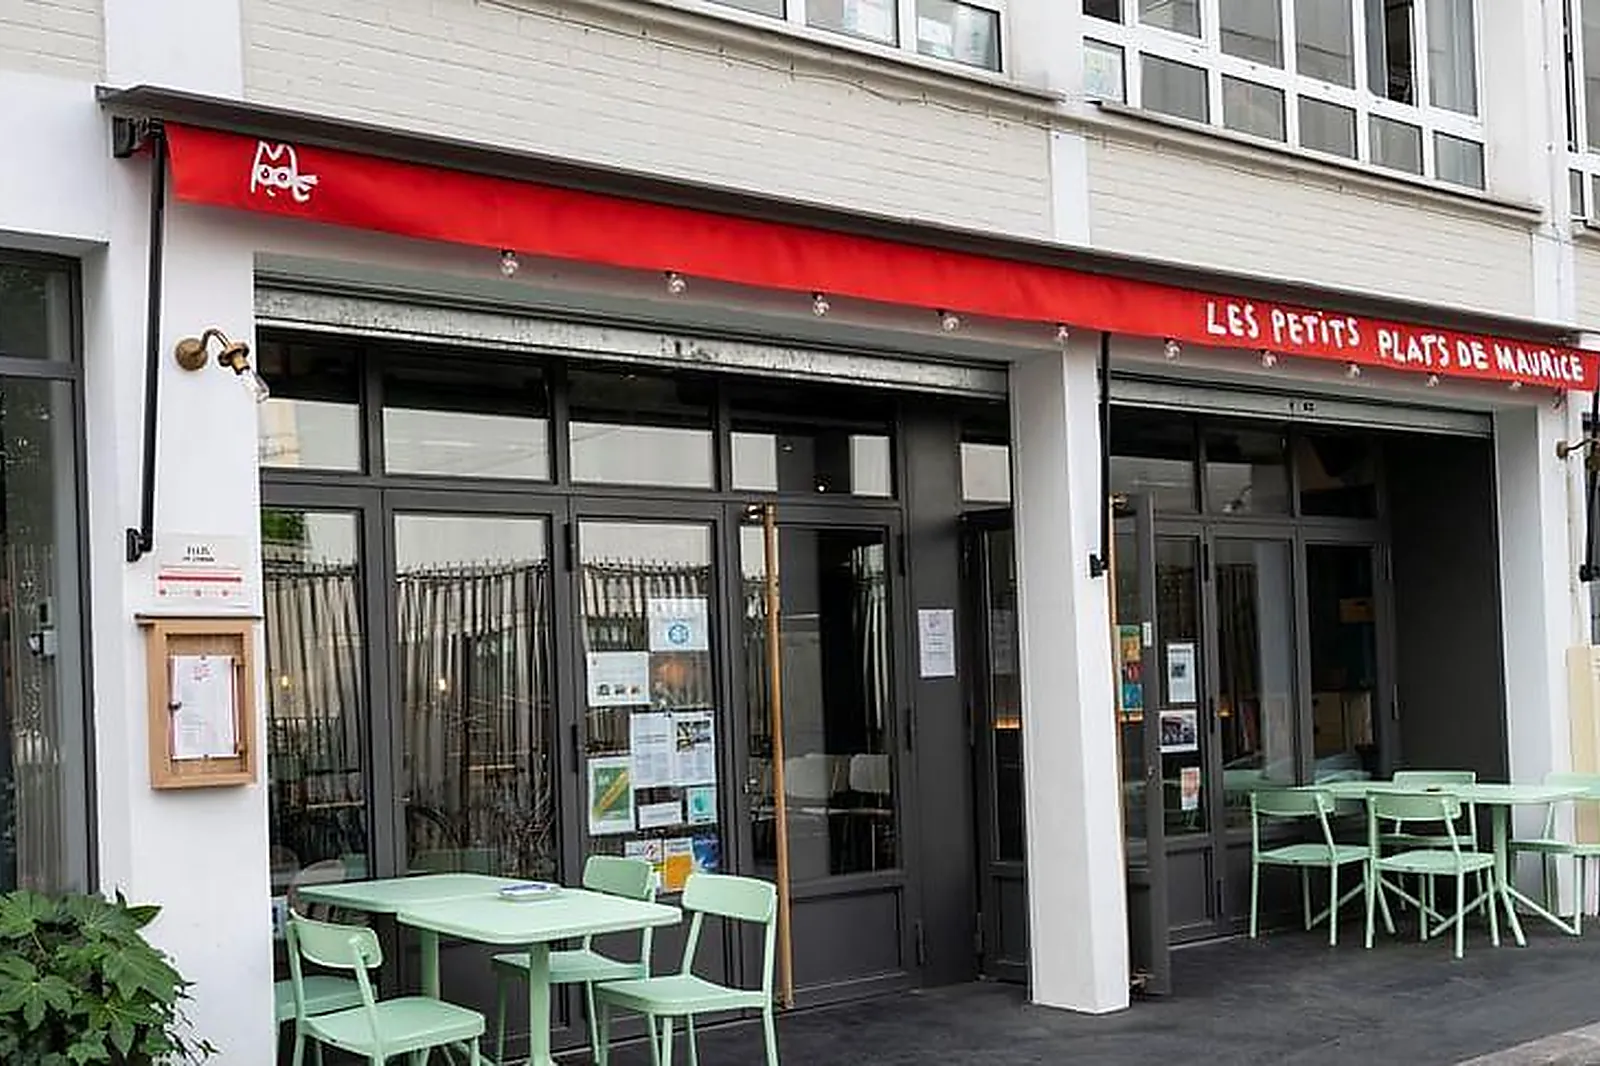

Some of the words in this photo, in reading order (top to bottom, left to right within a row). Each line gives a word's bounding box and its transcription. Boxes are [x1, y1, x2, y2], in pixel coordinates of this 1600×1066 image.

[1207, 302, 1259, 339] LES
[1377, 329, 1450, 367] PLATS
[1456, 340, 1489, 370] DE
